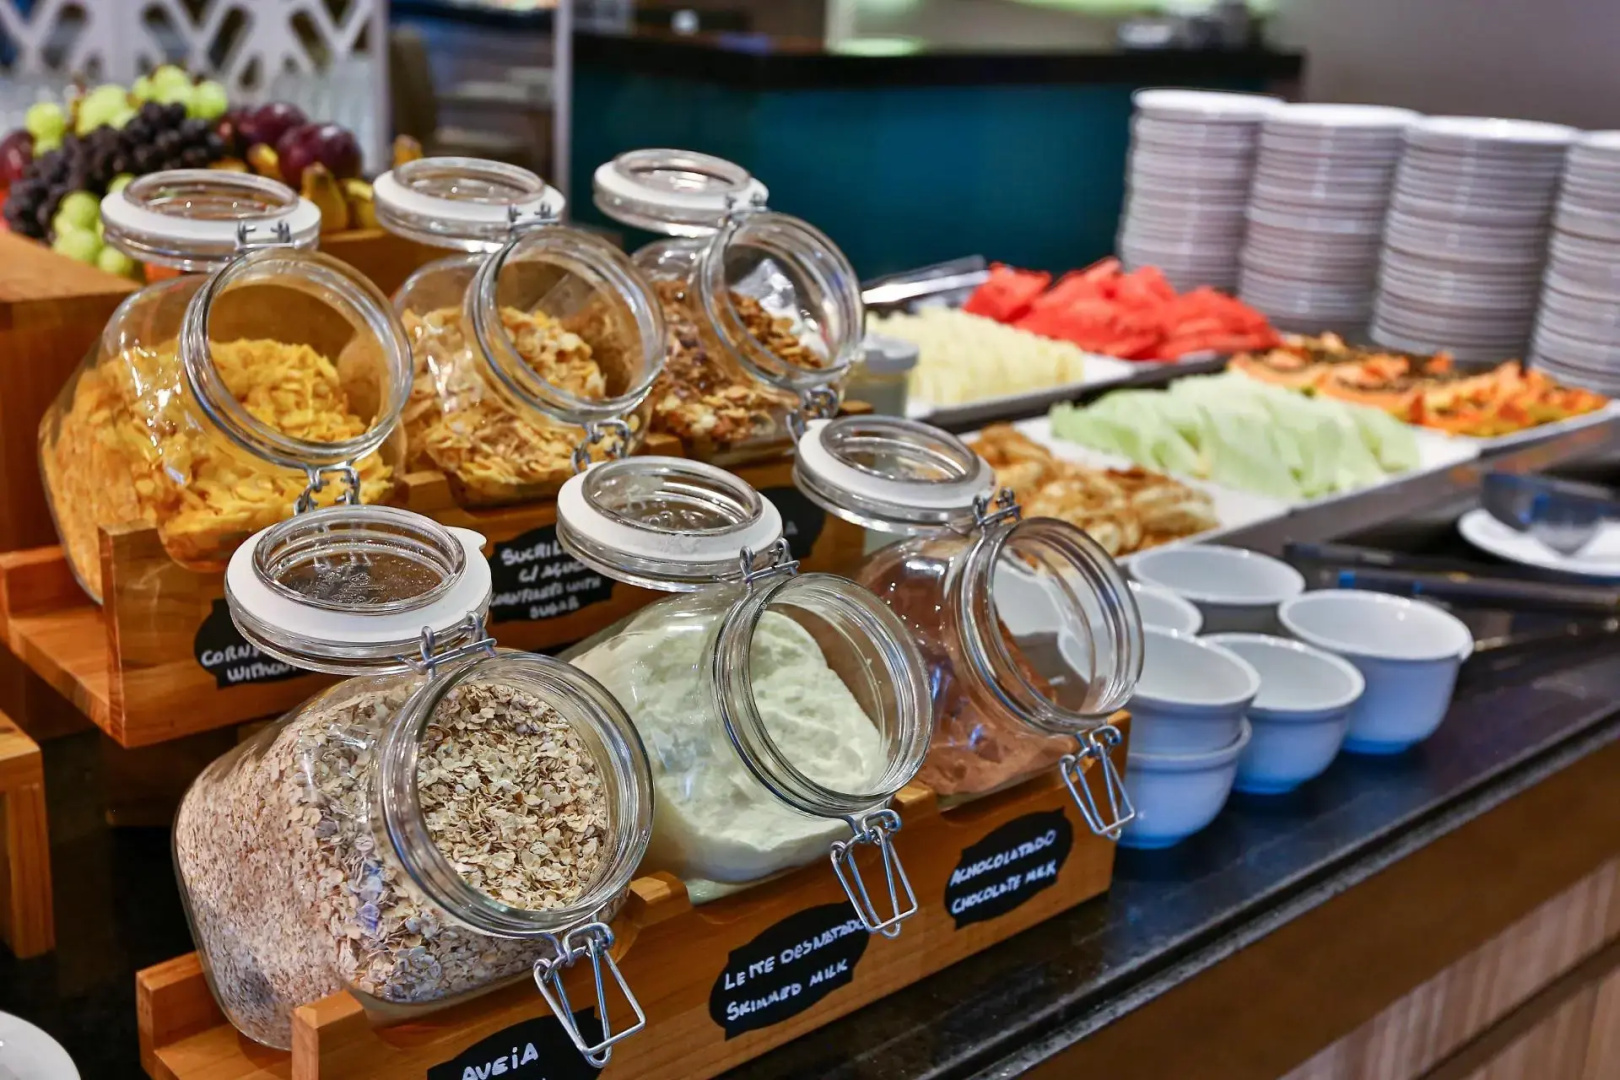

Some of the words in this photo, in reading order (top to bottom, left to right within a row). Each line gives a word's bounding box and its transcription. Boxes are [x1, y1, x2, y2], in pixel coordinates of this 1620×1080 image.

[501, 539, 569, 566] SUCRIL
[565, 576, 602, 593] WITH
[529, 594, 580, 619] SUGAR
[949, 829, 1057, 887] ACHOCOLATADO
[951, 874, 1022, 914] CHOCOLATE
[1024, 859, 1057, 884] MILK
[724, 955, 775, 991] LEITE
[726, 982, 803, 1021] SKIMMED
[809, 958, 849, 987] MILK
